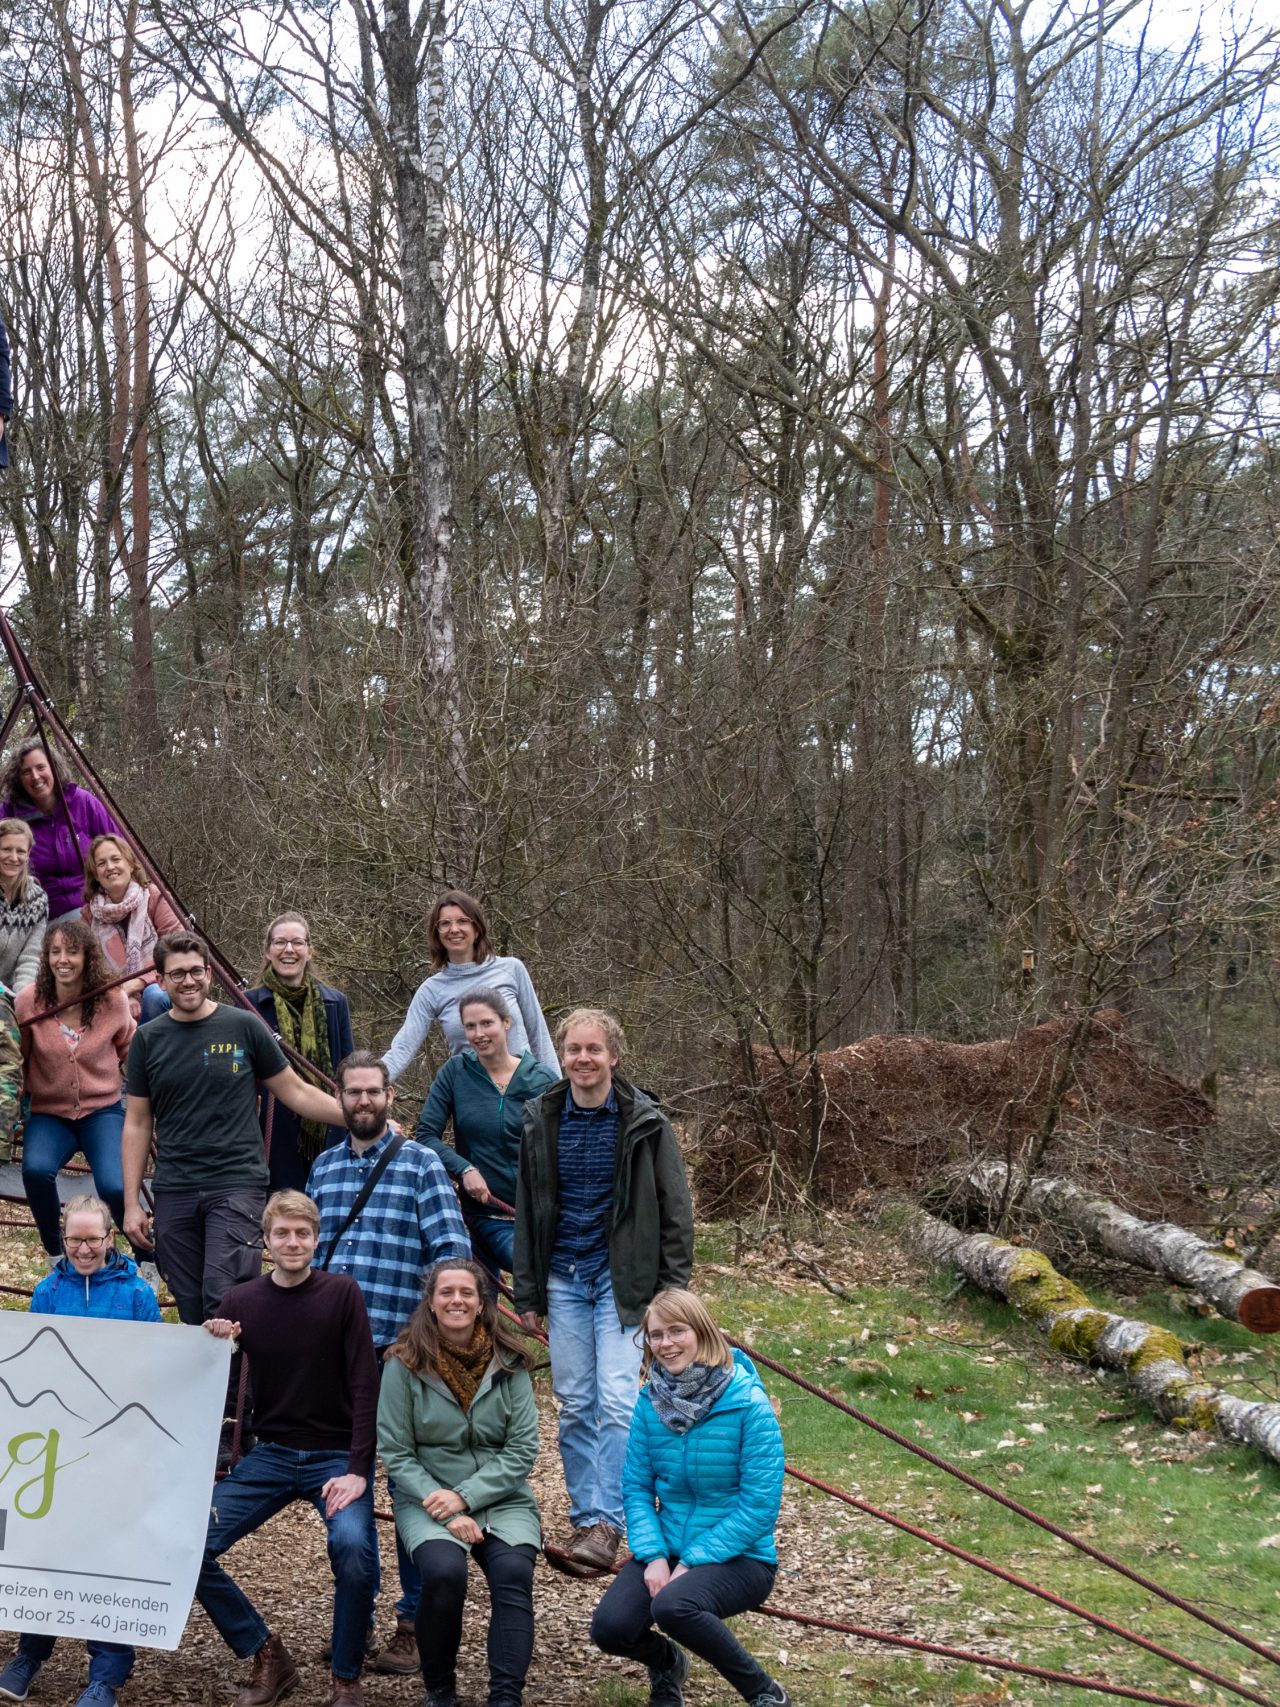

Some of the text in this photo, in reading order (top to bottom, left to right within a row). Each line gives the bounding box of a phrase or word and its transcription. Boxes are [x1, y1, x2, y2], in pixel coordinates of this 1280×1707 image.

[53, 1588, 74, 1601] en
[79, 1590, 169, 1614] weekenden
[13, 1606, 53, 1622] door
[56, 1610, 76, 1625] 25
[90, 1614, 111, 1629] 40
[112, 1616, 167, 1637] jarigen
